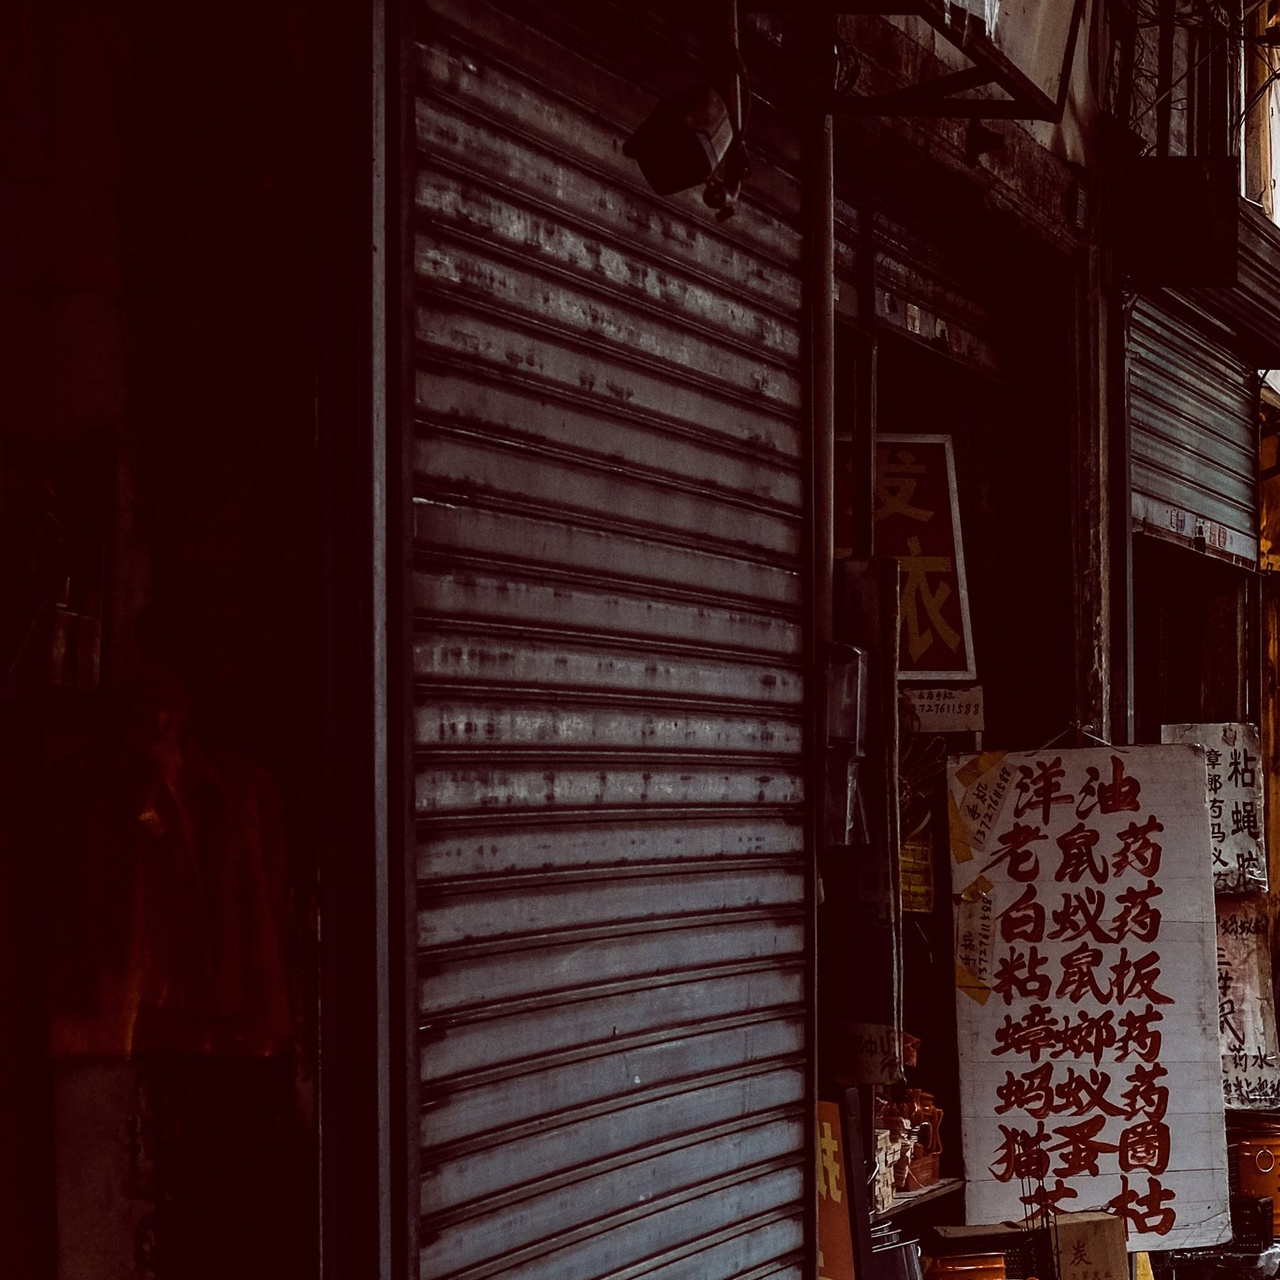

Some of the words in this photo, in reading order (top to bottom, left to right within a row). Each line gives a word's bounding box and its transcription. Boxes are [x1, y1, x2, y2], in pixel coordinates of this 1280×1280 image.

[1013, 754, 1141, 826] 洋油
[980, 814, 1164, 884] 老鼠药
[996, 880, 1163, 944] 白蚁药
[991, 1004, 1164, 1067] 蟑螂药
[994, 1062, 1171, 1121] 蚂蚁药
[1069, 1239, 1093, 1267] 炭
